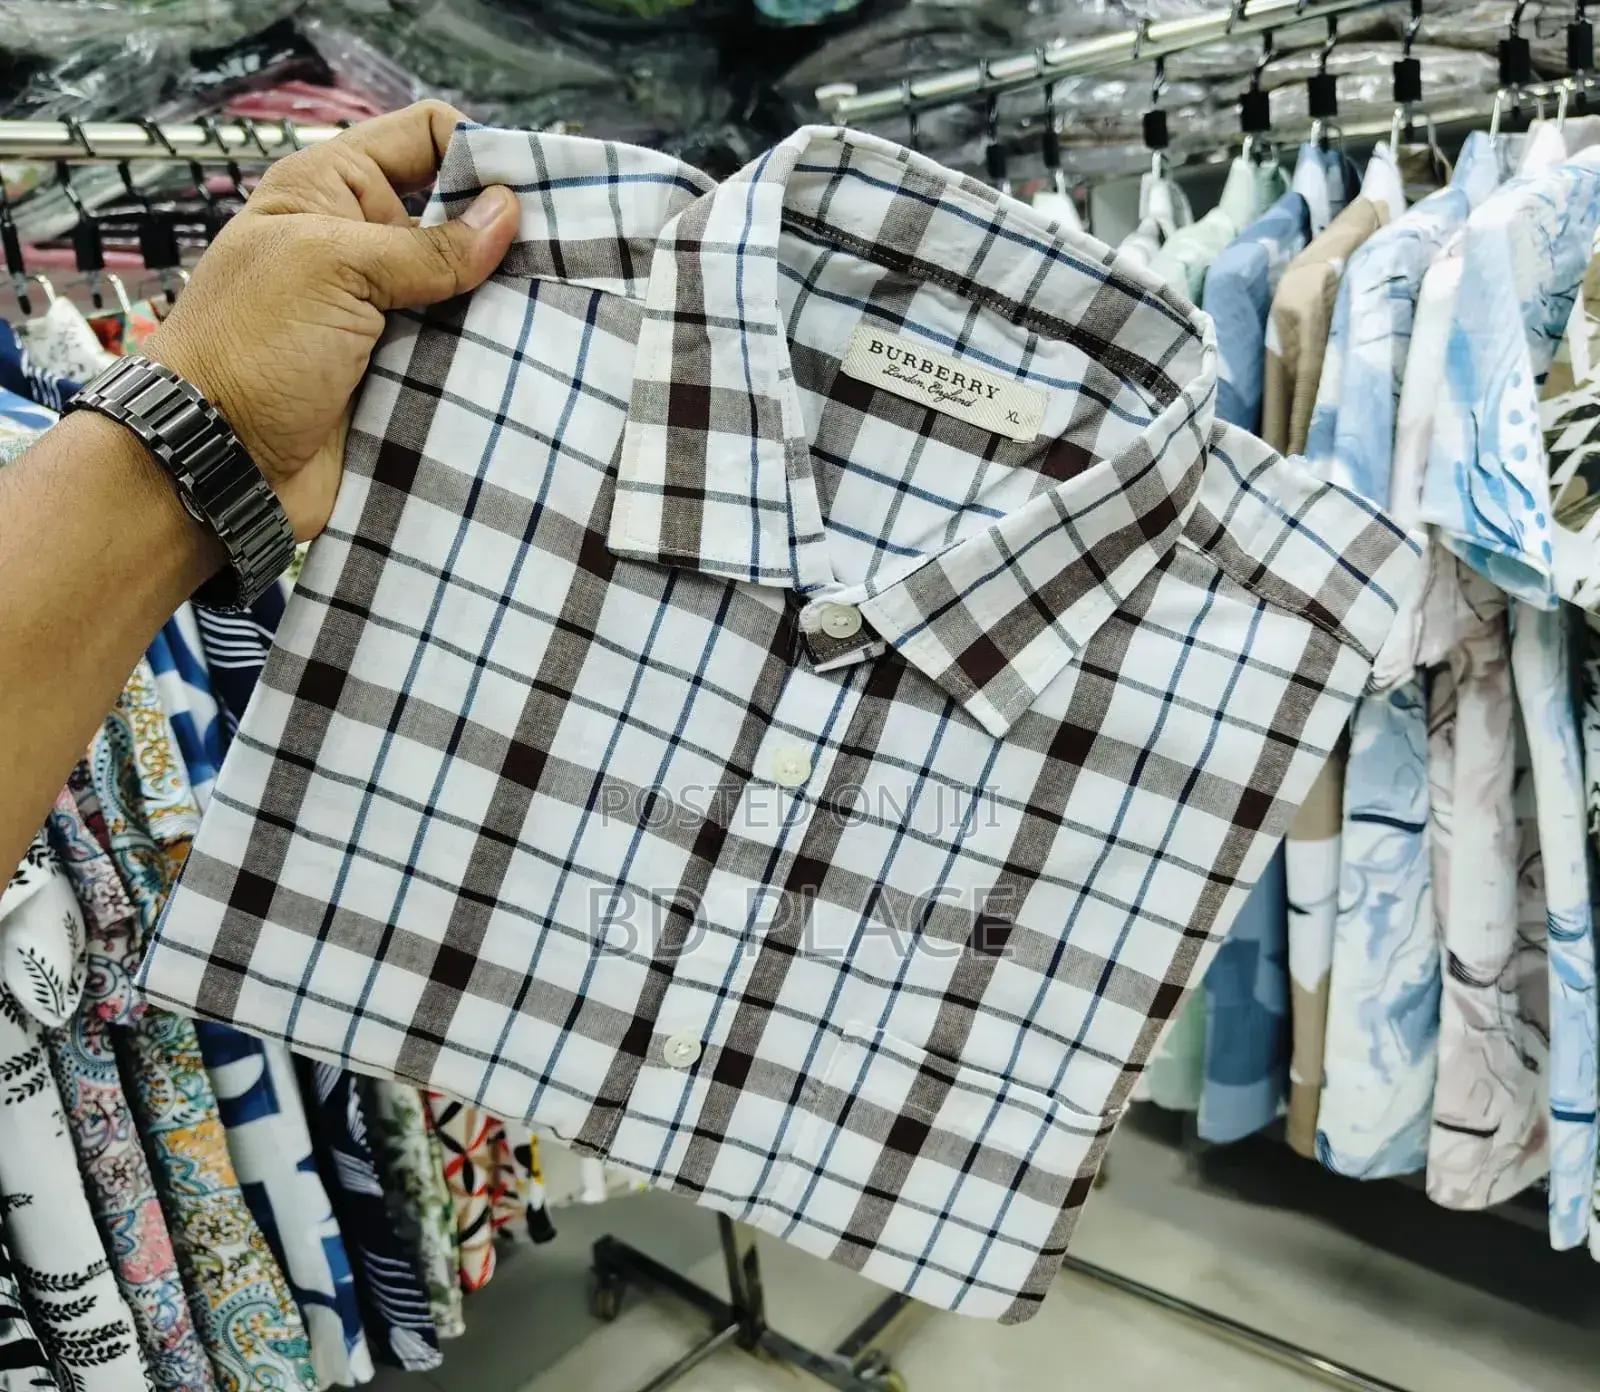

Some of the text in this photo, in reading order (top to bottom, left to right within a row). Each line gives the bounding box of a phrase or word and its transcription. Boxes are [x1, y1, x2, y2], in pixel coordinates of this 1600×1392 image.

[868, 340, 1000, 399] BURBERRY
[882, 364, 978, 408] London, England
[1005, 409, 1020, 425] XL
